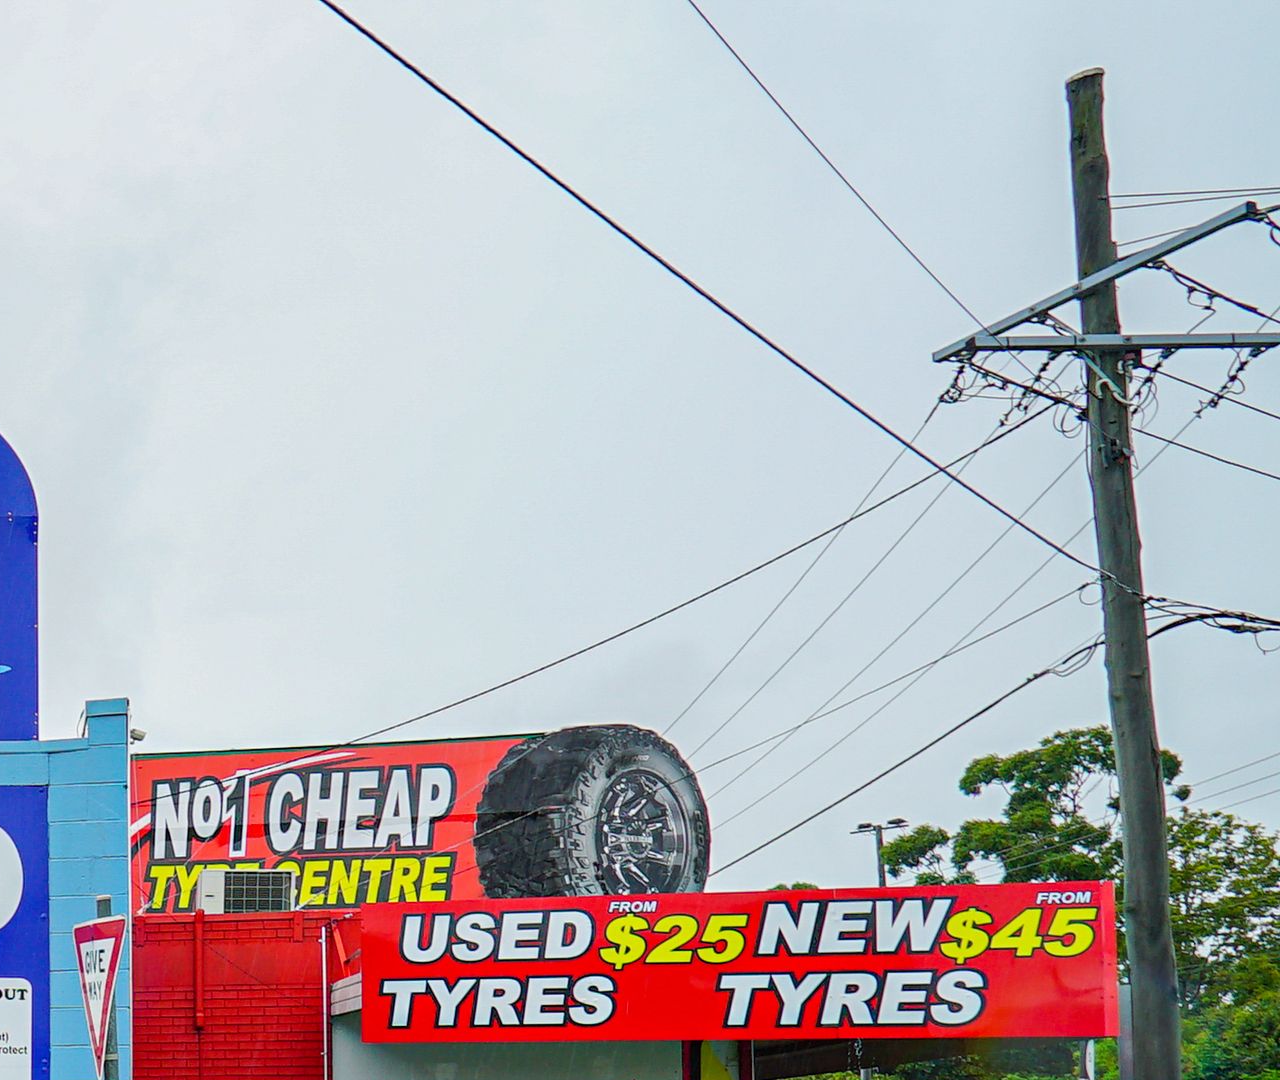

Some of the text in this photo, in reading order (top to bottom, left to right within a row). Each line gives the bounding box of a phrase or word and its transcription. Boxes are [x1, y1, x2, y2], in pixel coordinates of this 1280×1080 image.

[269, 765, 453, 853] CHEAP
[275, 857, 452, 905] ENTRE
[1037, 891, 1091, 904] FROM
[608, 901, 657, 913] FROM
[758, 898, 1097, 964] NEW $45
[85, 949, 106, 973] GIVE
[403, 912, 748, 969] USED $25
[383, 976, 613, 1026] TYRES
[720, 971, 983, 1025] TYRES
